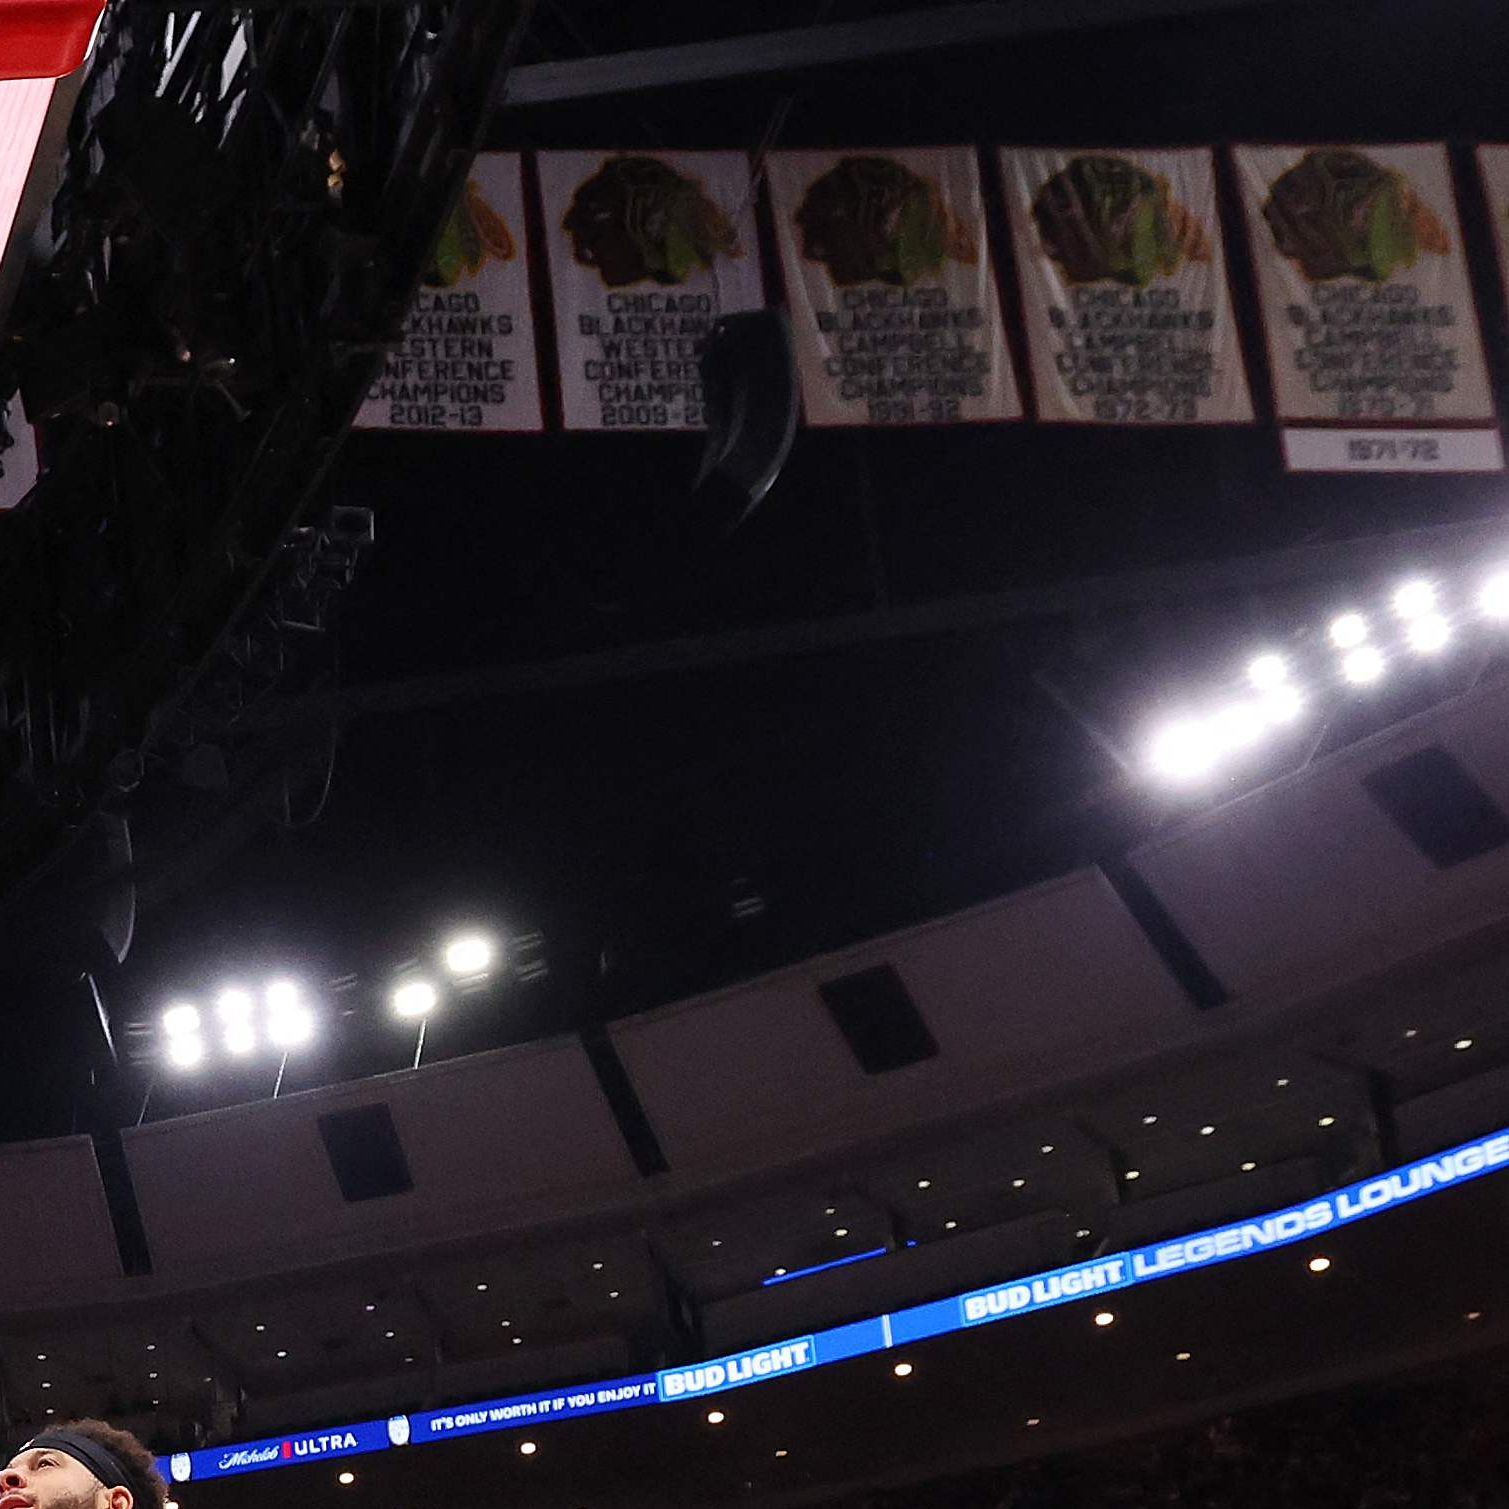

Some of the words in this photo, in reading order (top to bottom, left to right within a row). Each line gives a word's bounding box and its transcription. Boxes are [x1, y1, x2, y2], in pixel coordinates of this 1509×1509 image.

[608, 293, 711, 314] CHICAGO
[390, 405, 481, 426] 2012-13
[1133, 1206, 1333, 1276] LEGENDS
[1334, 1132, 1509, 1219] LOUNGE
[964, 1285, 1032, 1321] BUD
[1031, 1259, 1124, 1304] LIGHT
[663, 1364, 726, 1397] BUD
[726, 1341, 810, 1383] LIGHT
[218, 1445, 280, 1470] Michelob
[294, 1432, 357, 1456] ULTRA
